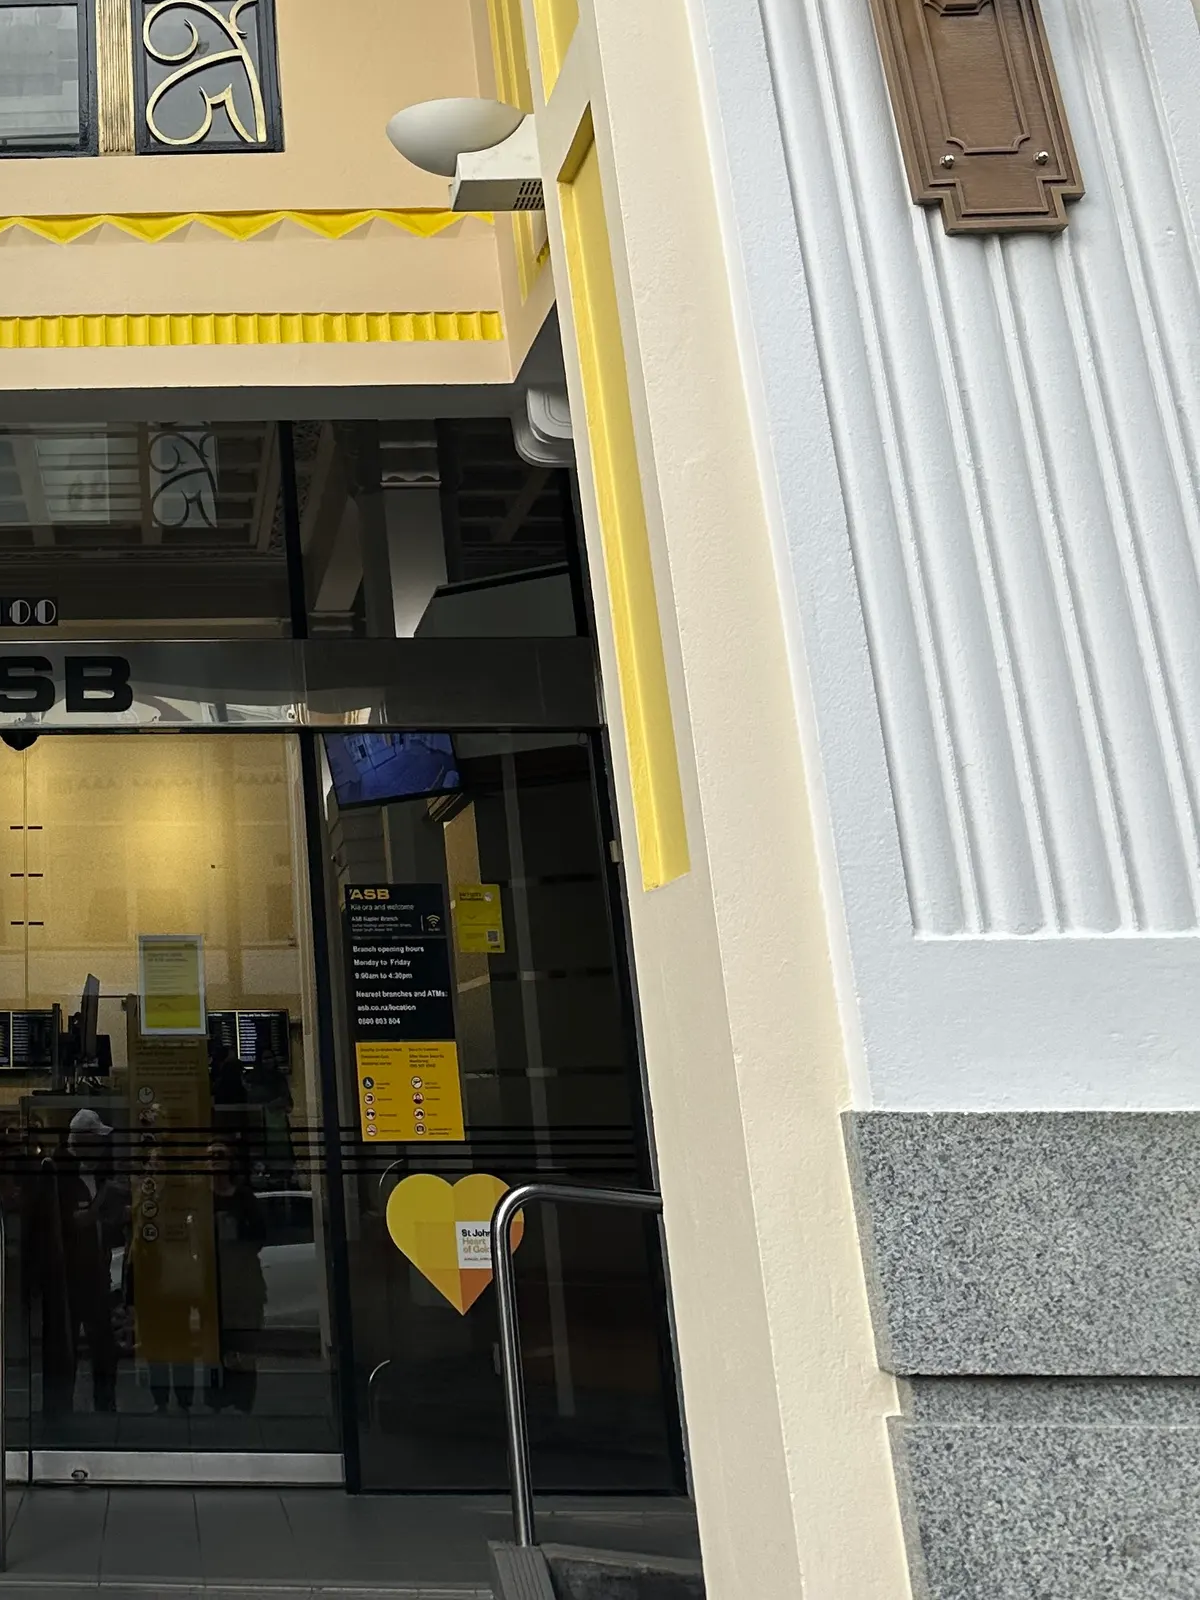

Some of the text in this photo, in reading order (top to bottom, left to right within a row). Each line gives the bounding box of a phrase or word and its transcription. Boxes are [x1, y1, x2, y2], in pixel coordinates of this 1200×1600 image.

[349, 888, 390, 900] ASB
[354, 959, 379, 967] Monday
[390, 958, 411, 967] Friday
